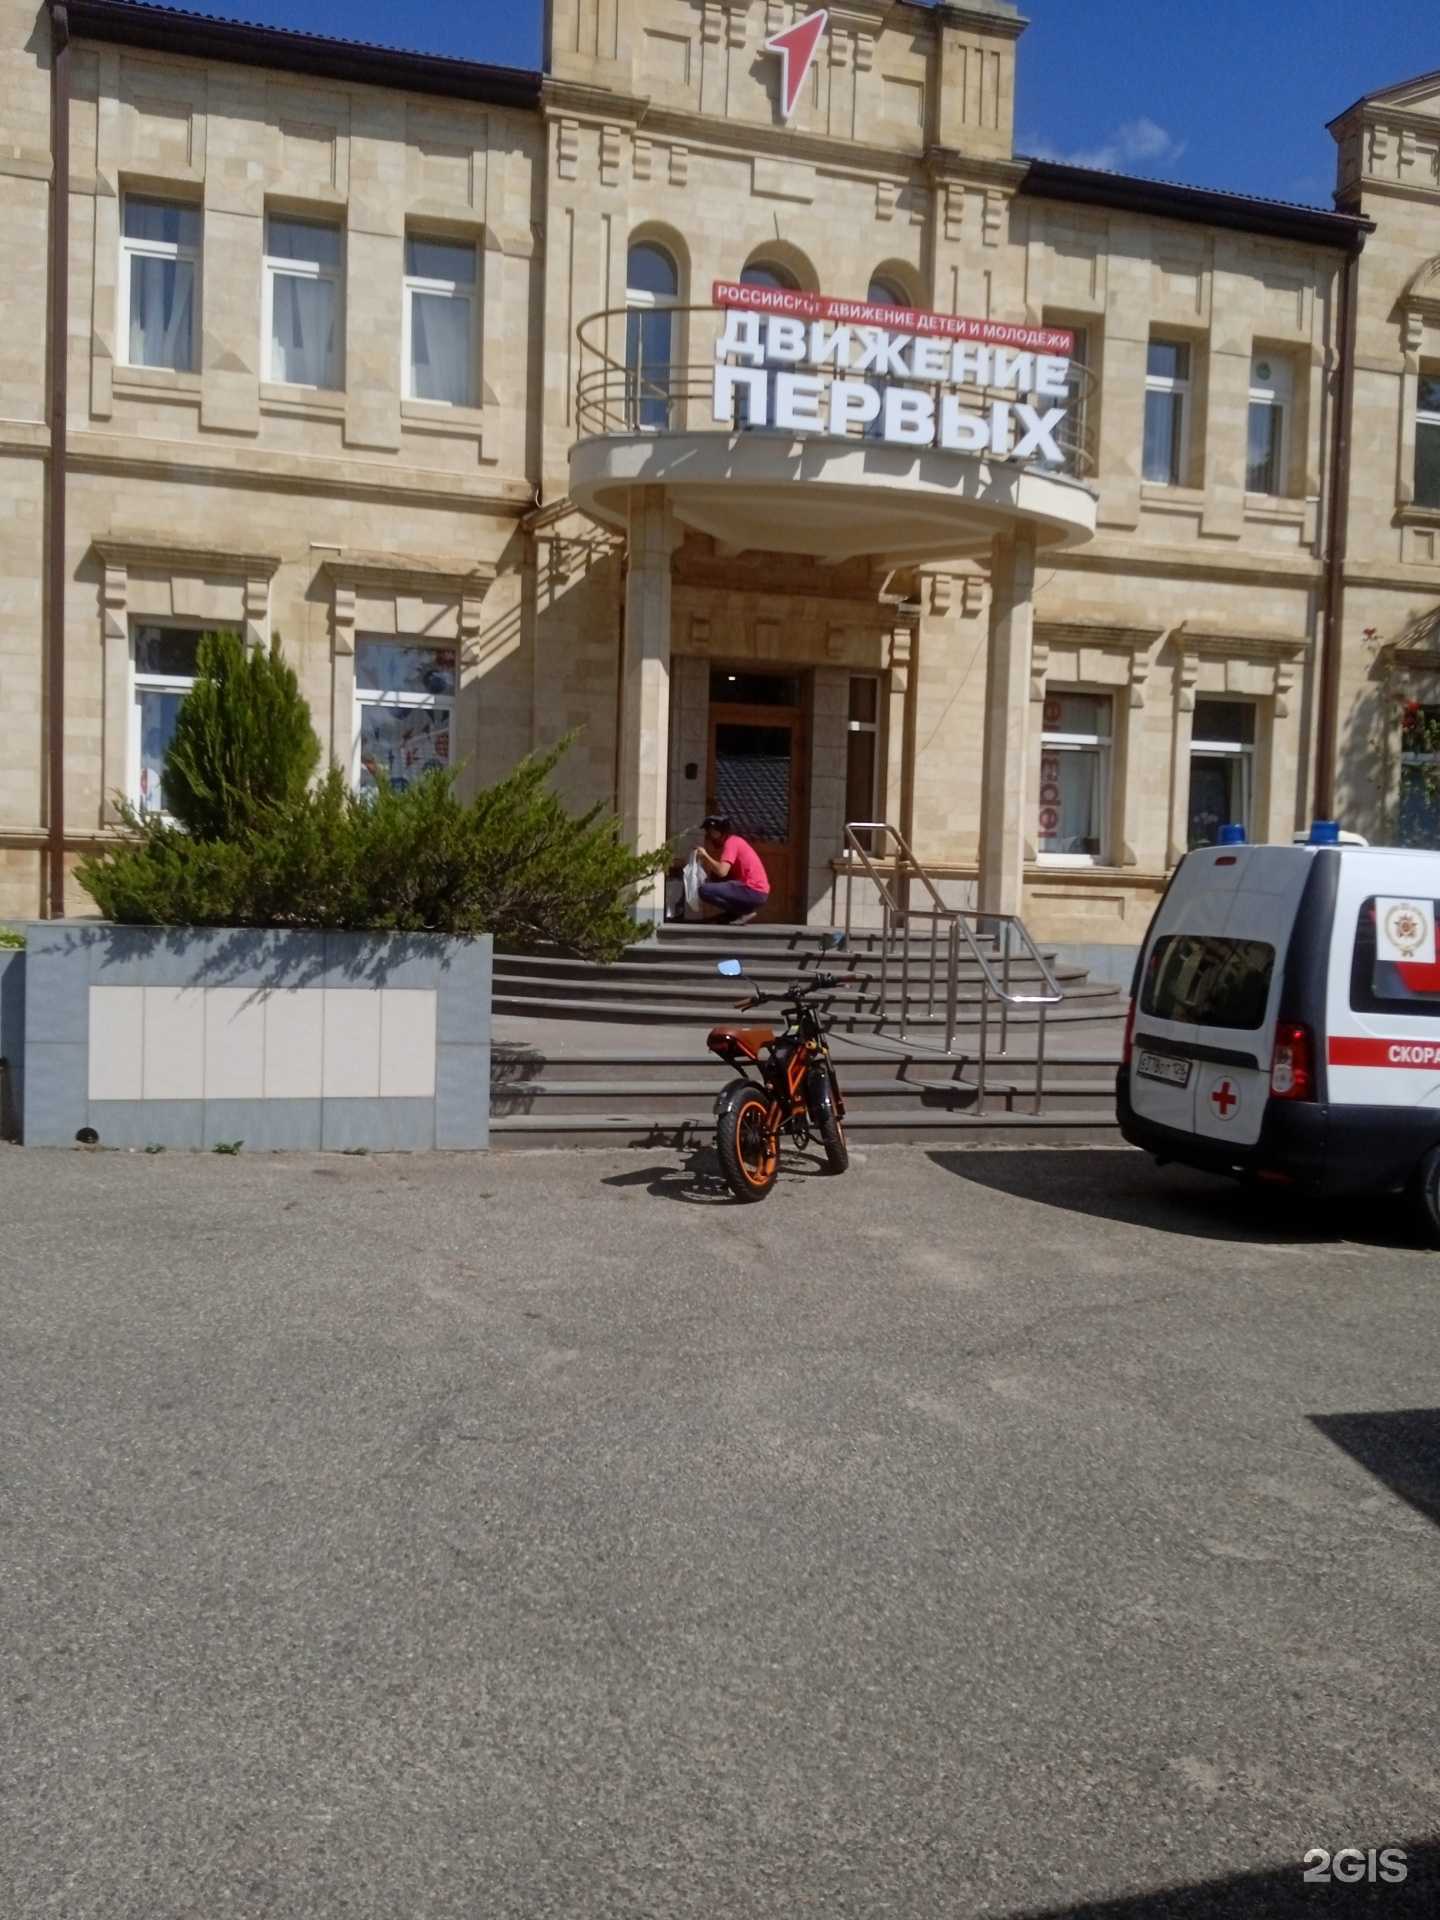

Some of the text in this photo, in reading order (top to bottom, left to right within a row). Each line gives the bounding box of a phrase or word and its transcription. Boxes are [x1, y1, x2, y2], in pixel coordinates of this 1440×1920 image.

[714, 309, 1071, 397] ДВИЖЕНИЕ
[827, 301, 915, 325] ДВИЖЕНИЕ
[916, 314, 966, 333] ДЕТЕЙ
[969, 322, 980, 336] И
[983, 323, 1070, 348] МОЛОДЕЖИ
[713, 364, 1068, 462] ПЕРВЫХ
